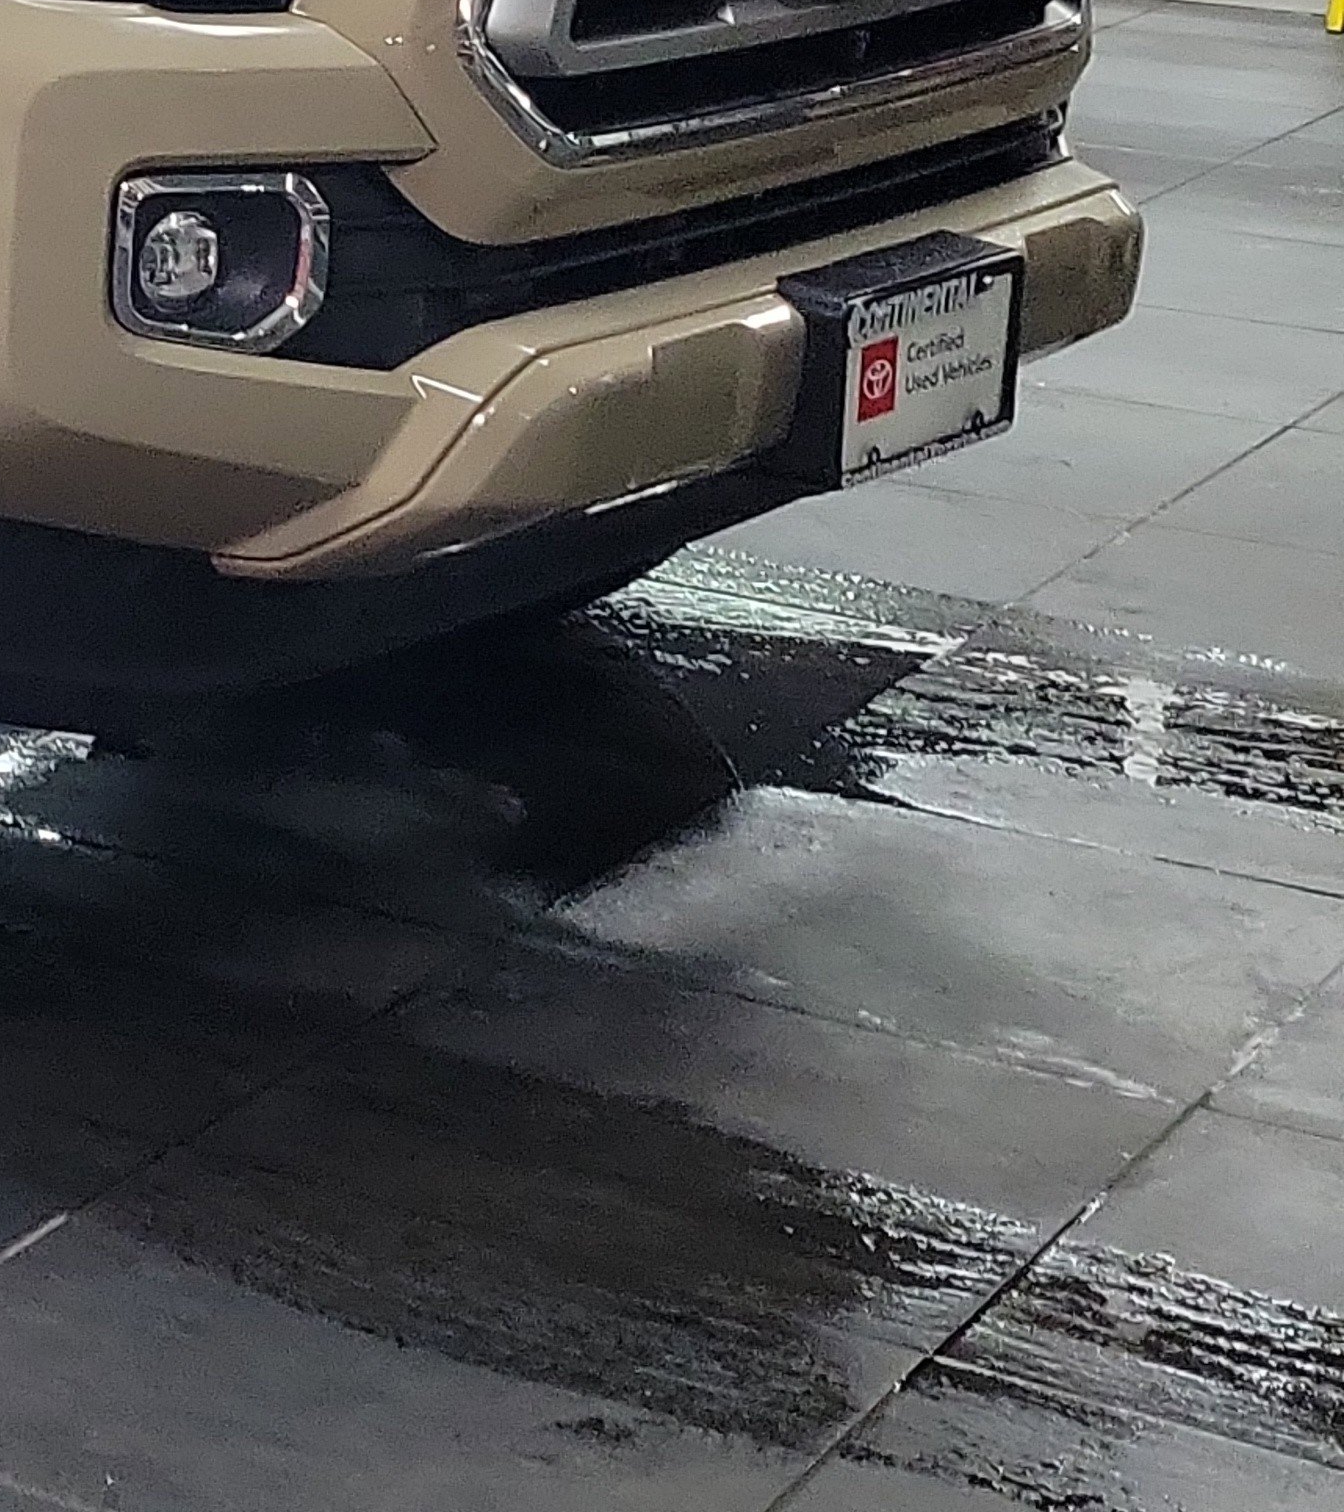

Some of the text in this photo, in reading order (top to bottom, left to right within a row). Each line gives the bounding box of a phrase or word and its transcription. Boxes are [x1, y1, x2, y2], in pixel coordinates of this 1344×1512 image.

[907, 326, 965, 363] Certified
[905, 353, 992, 395] Used Vehicles
